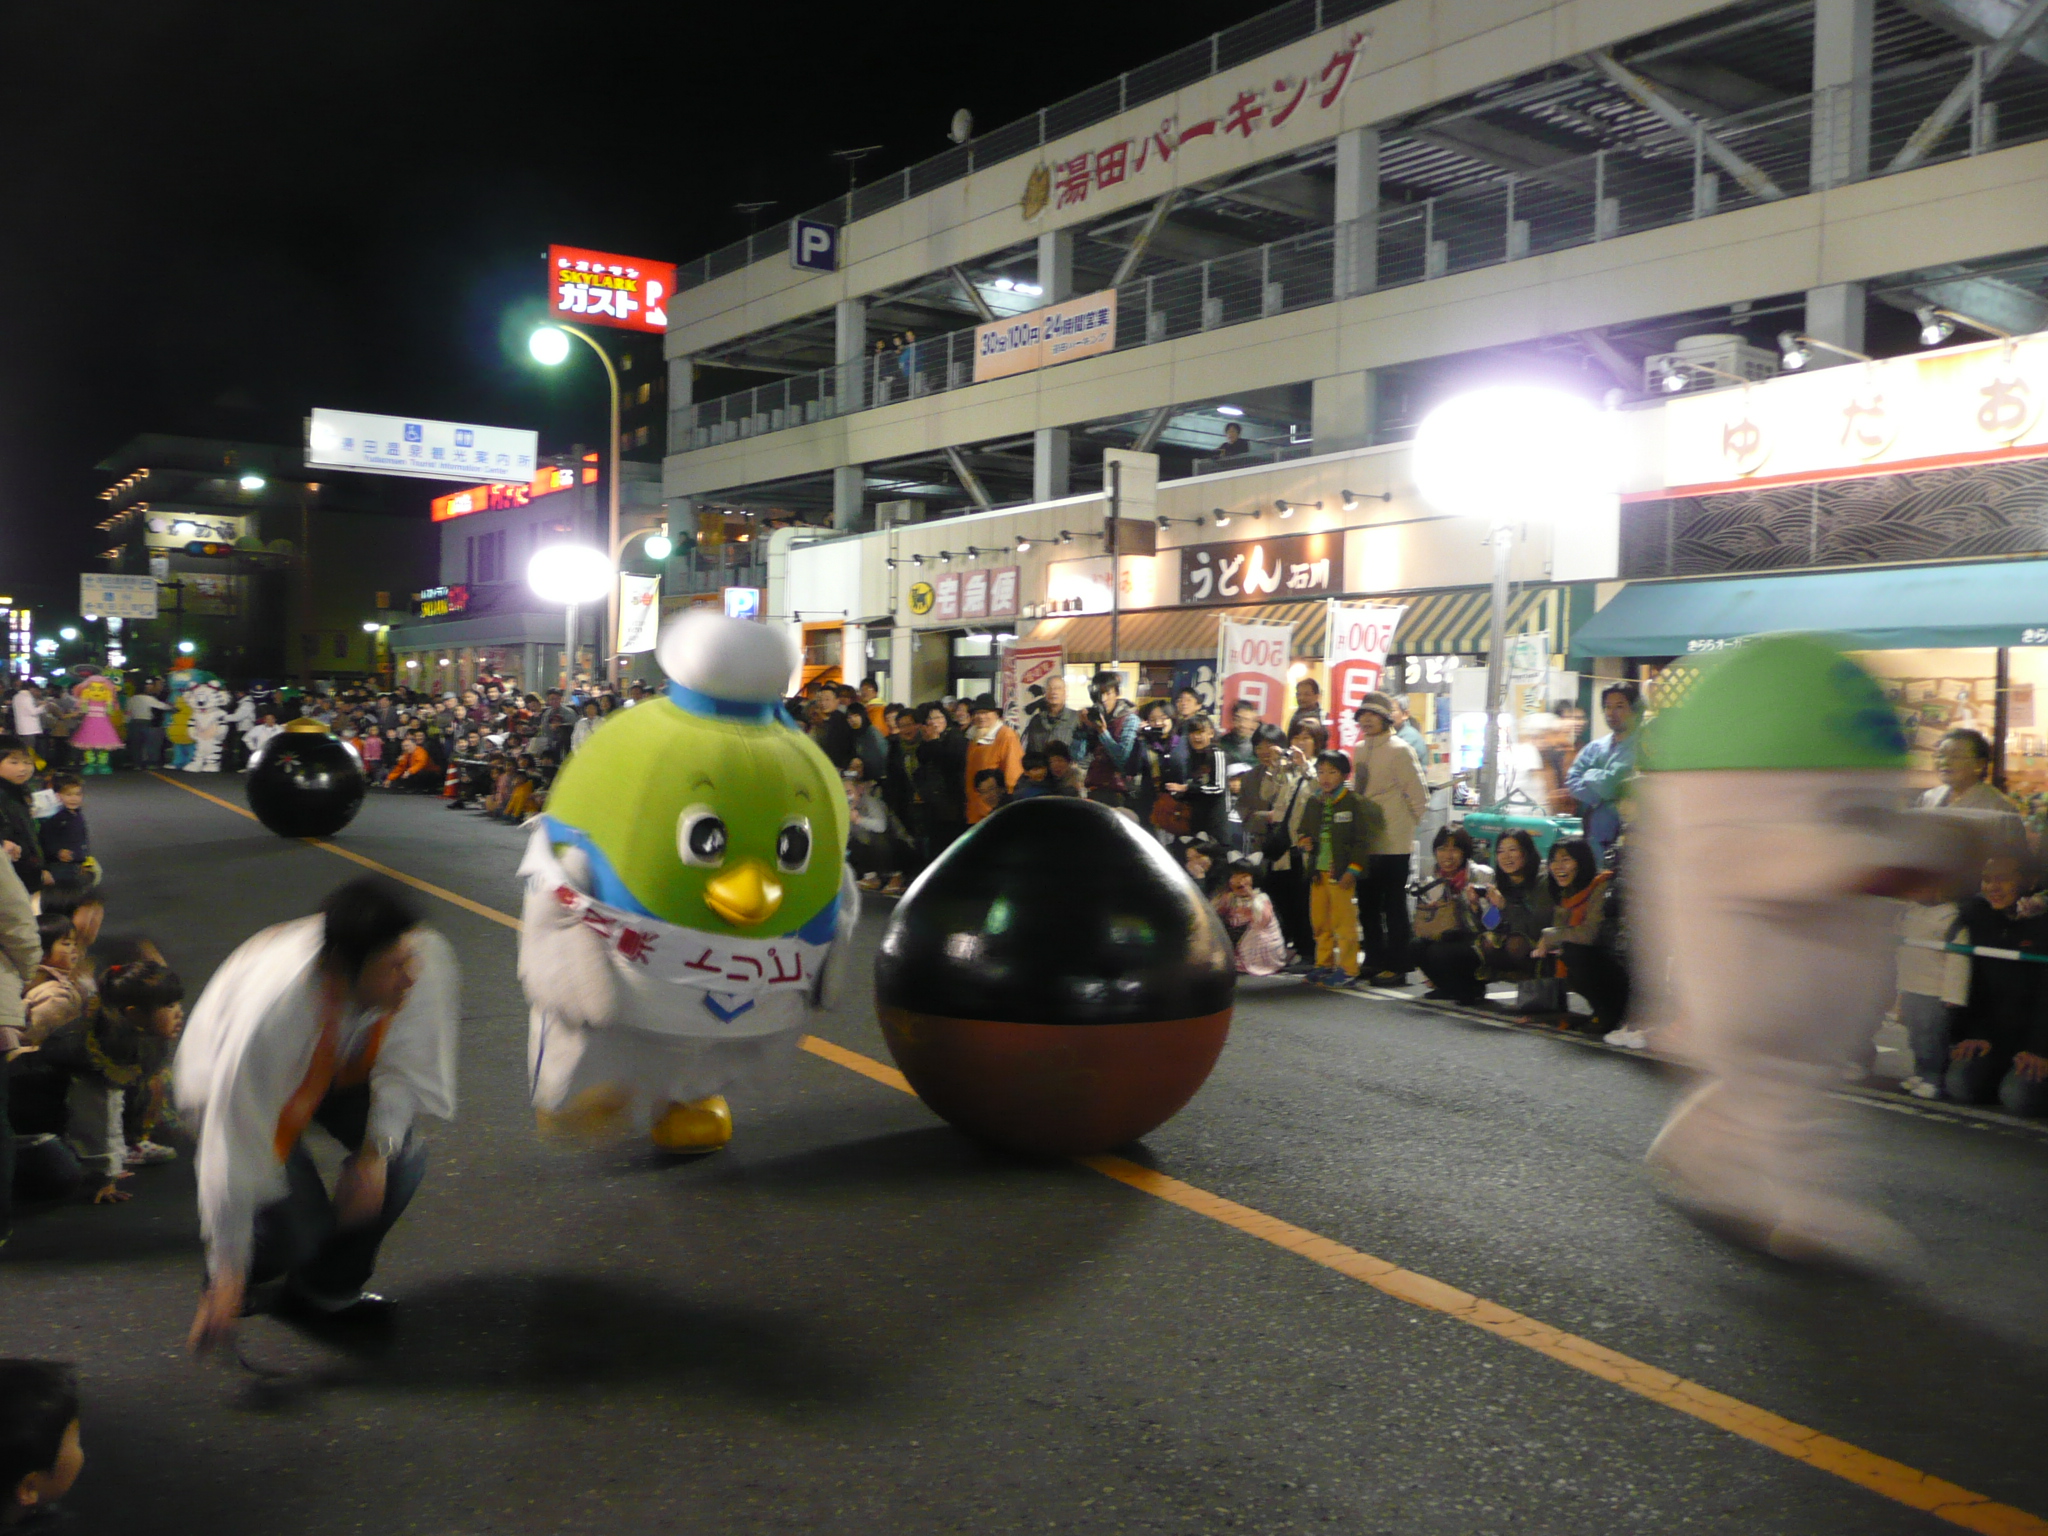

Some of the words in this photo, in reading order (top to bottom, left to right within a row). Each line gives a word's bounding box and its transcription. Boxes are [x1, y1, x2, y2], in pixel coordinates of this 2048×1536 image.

[1055, 32, 1364, 210] 湯田パーキング
[802, 226, 831, 262] P
[558, 258, 640, 278] レストラン
[558, 269, 638, 292] SKYLARK
[558, 283, 639, 319] ガスト
[646, 280, 663, 307] P
[980, 322, 1041, 357] 30分100円
[1043, 306, 1110, 341] 24時間営業
[1190, 545, 1282, 599] うどん
[1286, 558, 1330, 590] 石川
[936, 571, 1018, 615] 宅急便
[684, 948, 812, 985] トリピ
